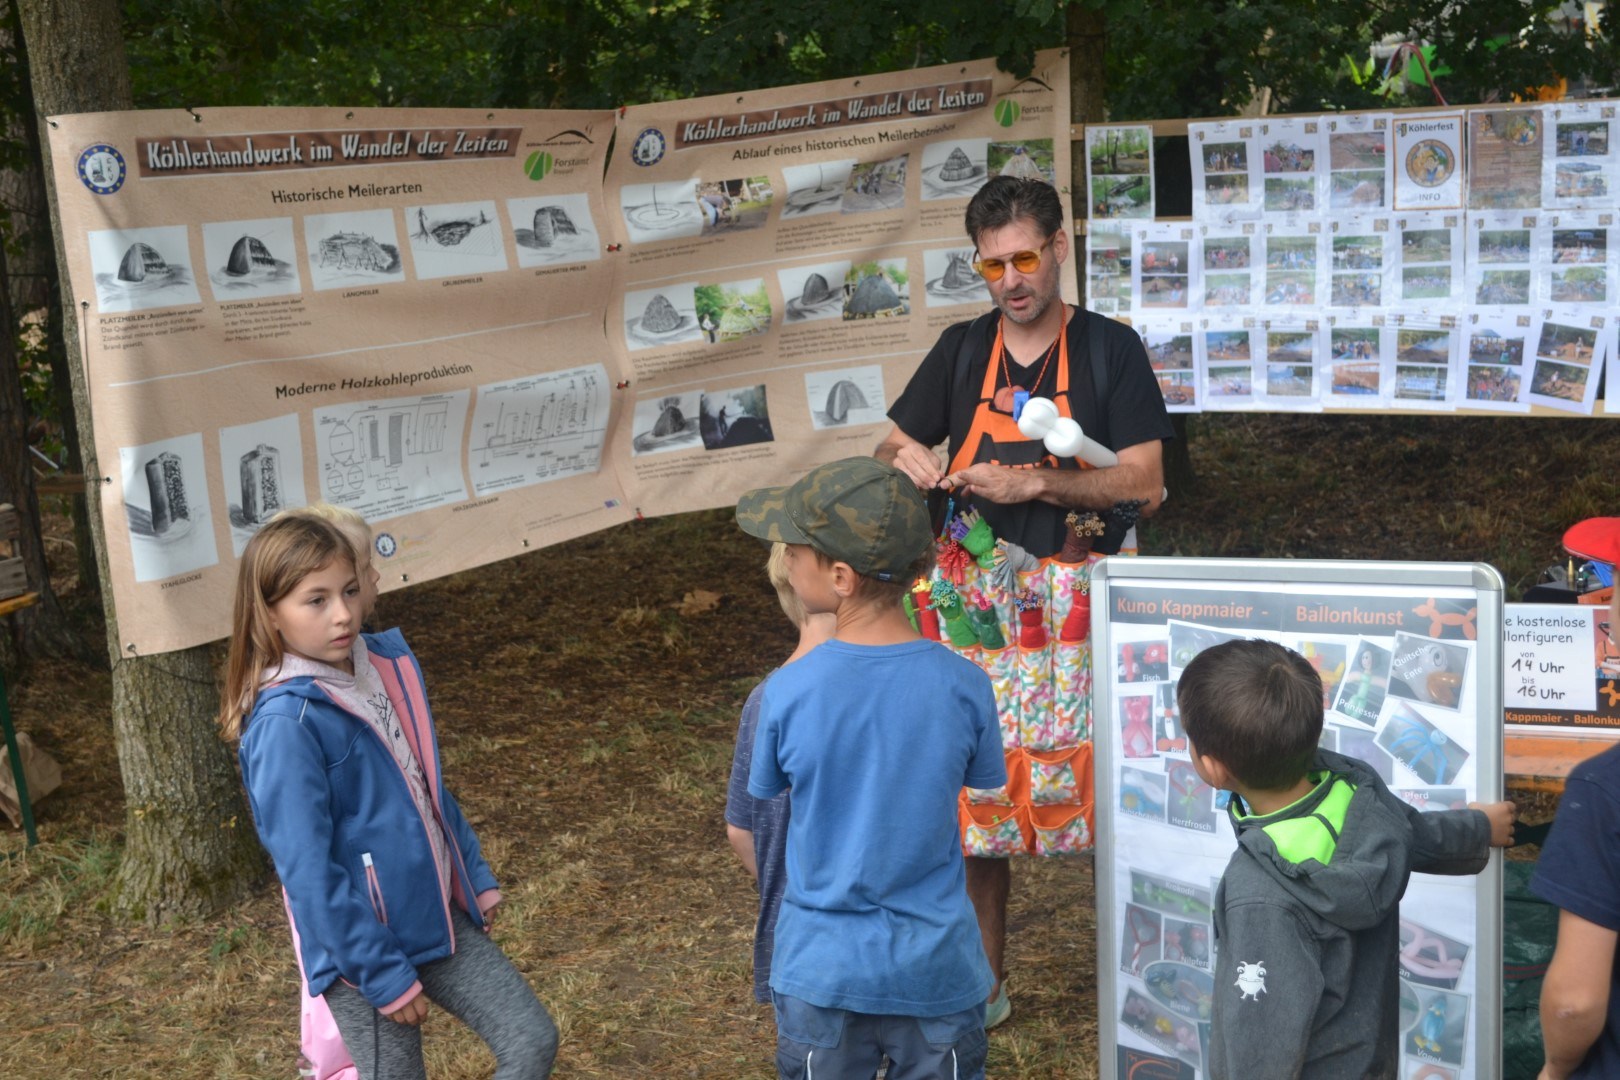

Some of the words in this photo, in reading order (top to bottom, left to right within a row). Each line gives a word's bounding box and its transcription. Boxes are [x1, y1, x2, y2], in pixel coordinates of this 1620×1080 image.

[684, 105, 816, 142] Köhlerhandwerk
[822, 108, 841, 123] im
[848, 93, 902, 120] Wandel
[907, 91, 933, 112] der
[938, 88, 985, 108] Zeiten
[1408, 122, 1454, 133] Köhlerfest
[148, 136, 302, 169] Köhlerhandwerk
[310, 141, 332, 161] im
[341, 132, 411, 159] Wandel
[417, 131, 448, 156] der
[453, 131, 509, 154] Zeiten
[732, 144, 771, 161] Ablauf
[773, 141, 802, 155] eines
[805, 132, 876, 151] historischen
[271, 186, 345, 204] Historische
[348, 182, 423, 199] Meilerarten
[1418, 193, 1441, 201] INFO
[342, 289, 379, 299] LANGMEILER
[100, 313, 146, 324] PLATZMEILER
[275, 380, 337, 400] Moderne
[341, 363, 473, 390] Holzkohleproduktion
[1116, 598, 1157, 615] Kuno
[1161, 599, 1254, 622] Kappmaier
[1296, 605, 1403, 626] Ballonkunst
[1517, 616, 1586, 628] kostenlose
[1503, 631, 1573, 646] llonfiguren
[1511, 658, 1533, 672] 14
[1540, 662, 1565, 673] Uhr
[1142, 673, 1161, 682] Fisch
[1403, 666, 1423, 681] Ente
[1521, 676, 1535, 684] bis
[1517, 685, 1537, 697] 16
[1540, 688, 1565, 700] Uhr
[1339, 697, 1380, 721] Prinzessin
[1505, 711, 1562, 724] Kappmaier
[1574, 714, 1620, 726] Ballonku
[1405, 791, 1429, 800] Pferd
[1171, 815, 1212, 831] Herzfrosch
